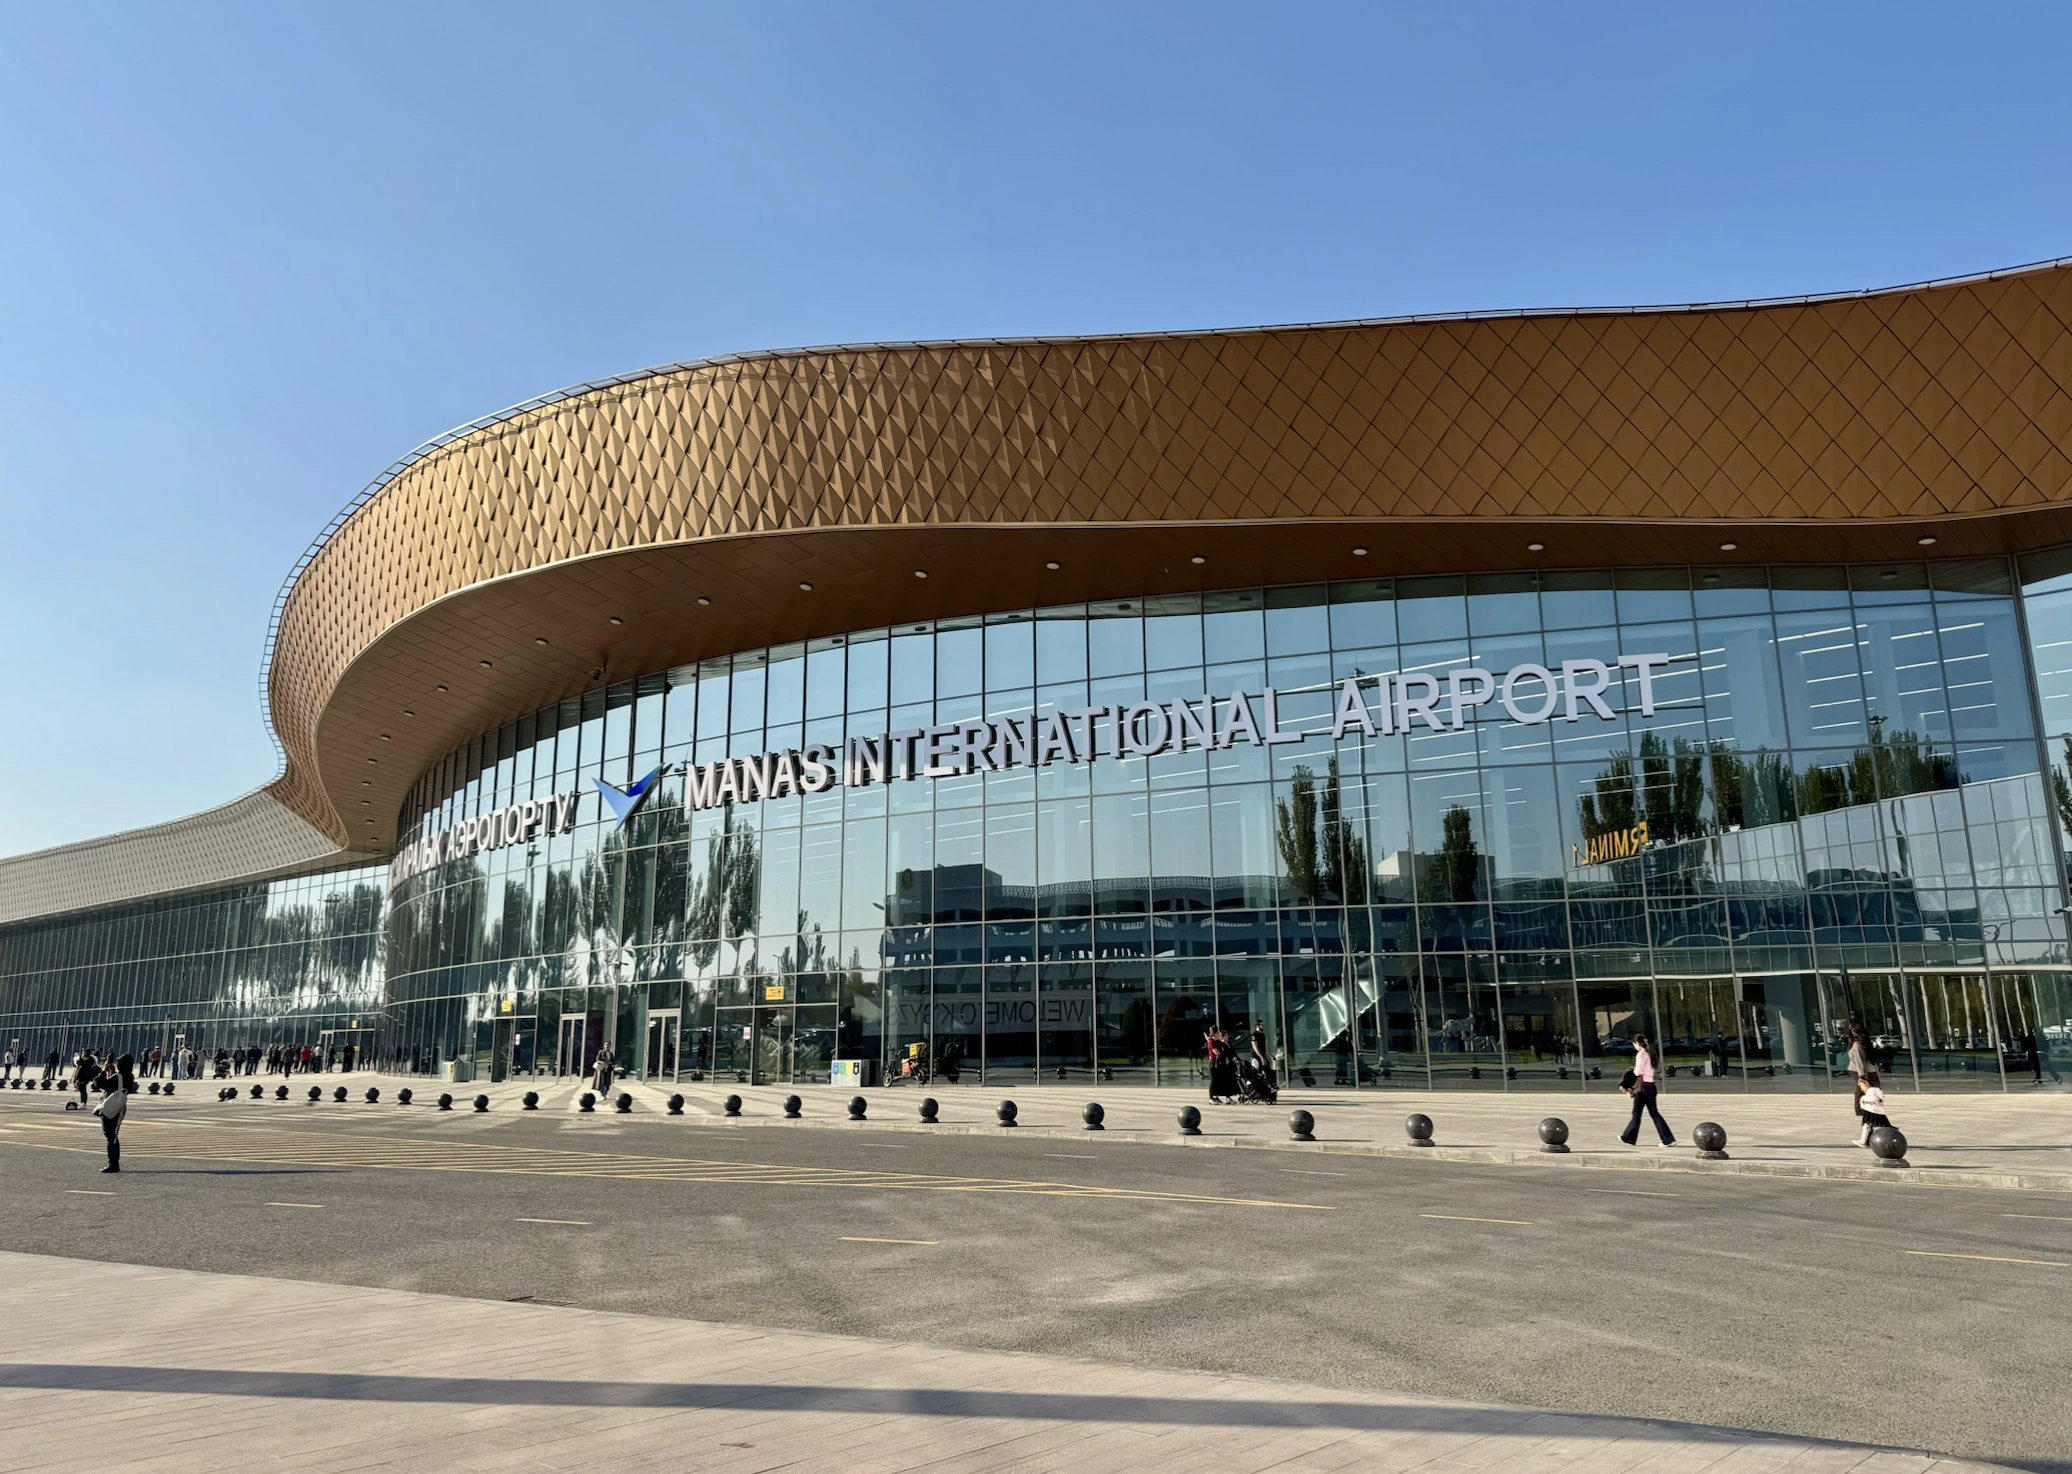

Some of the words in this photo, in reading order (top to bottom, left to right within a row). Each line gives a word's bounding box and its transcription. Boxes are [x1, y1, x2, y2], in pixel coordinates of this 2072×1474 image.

[685, 743, 831, 811] MANAS
[844, 687, 1303, 786] INTERNATIONAL
[1332, 653, 1668, 739] AIRPORT
[445, 790, 574, 861] АЭРОПОРТУ
